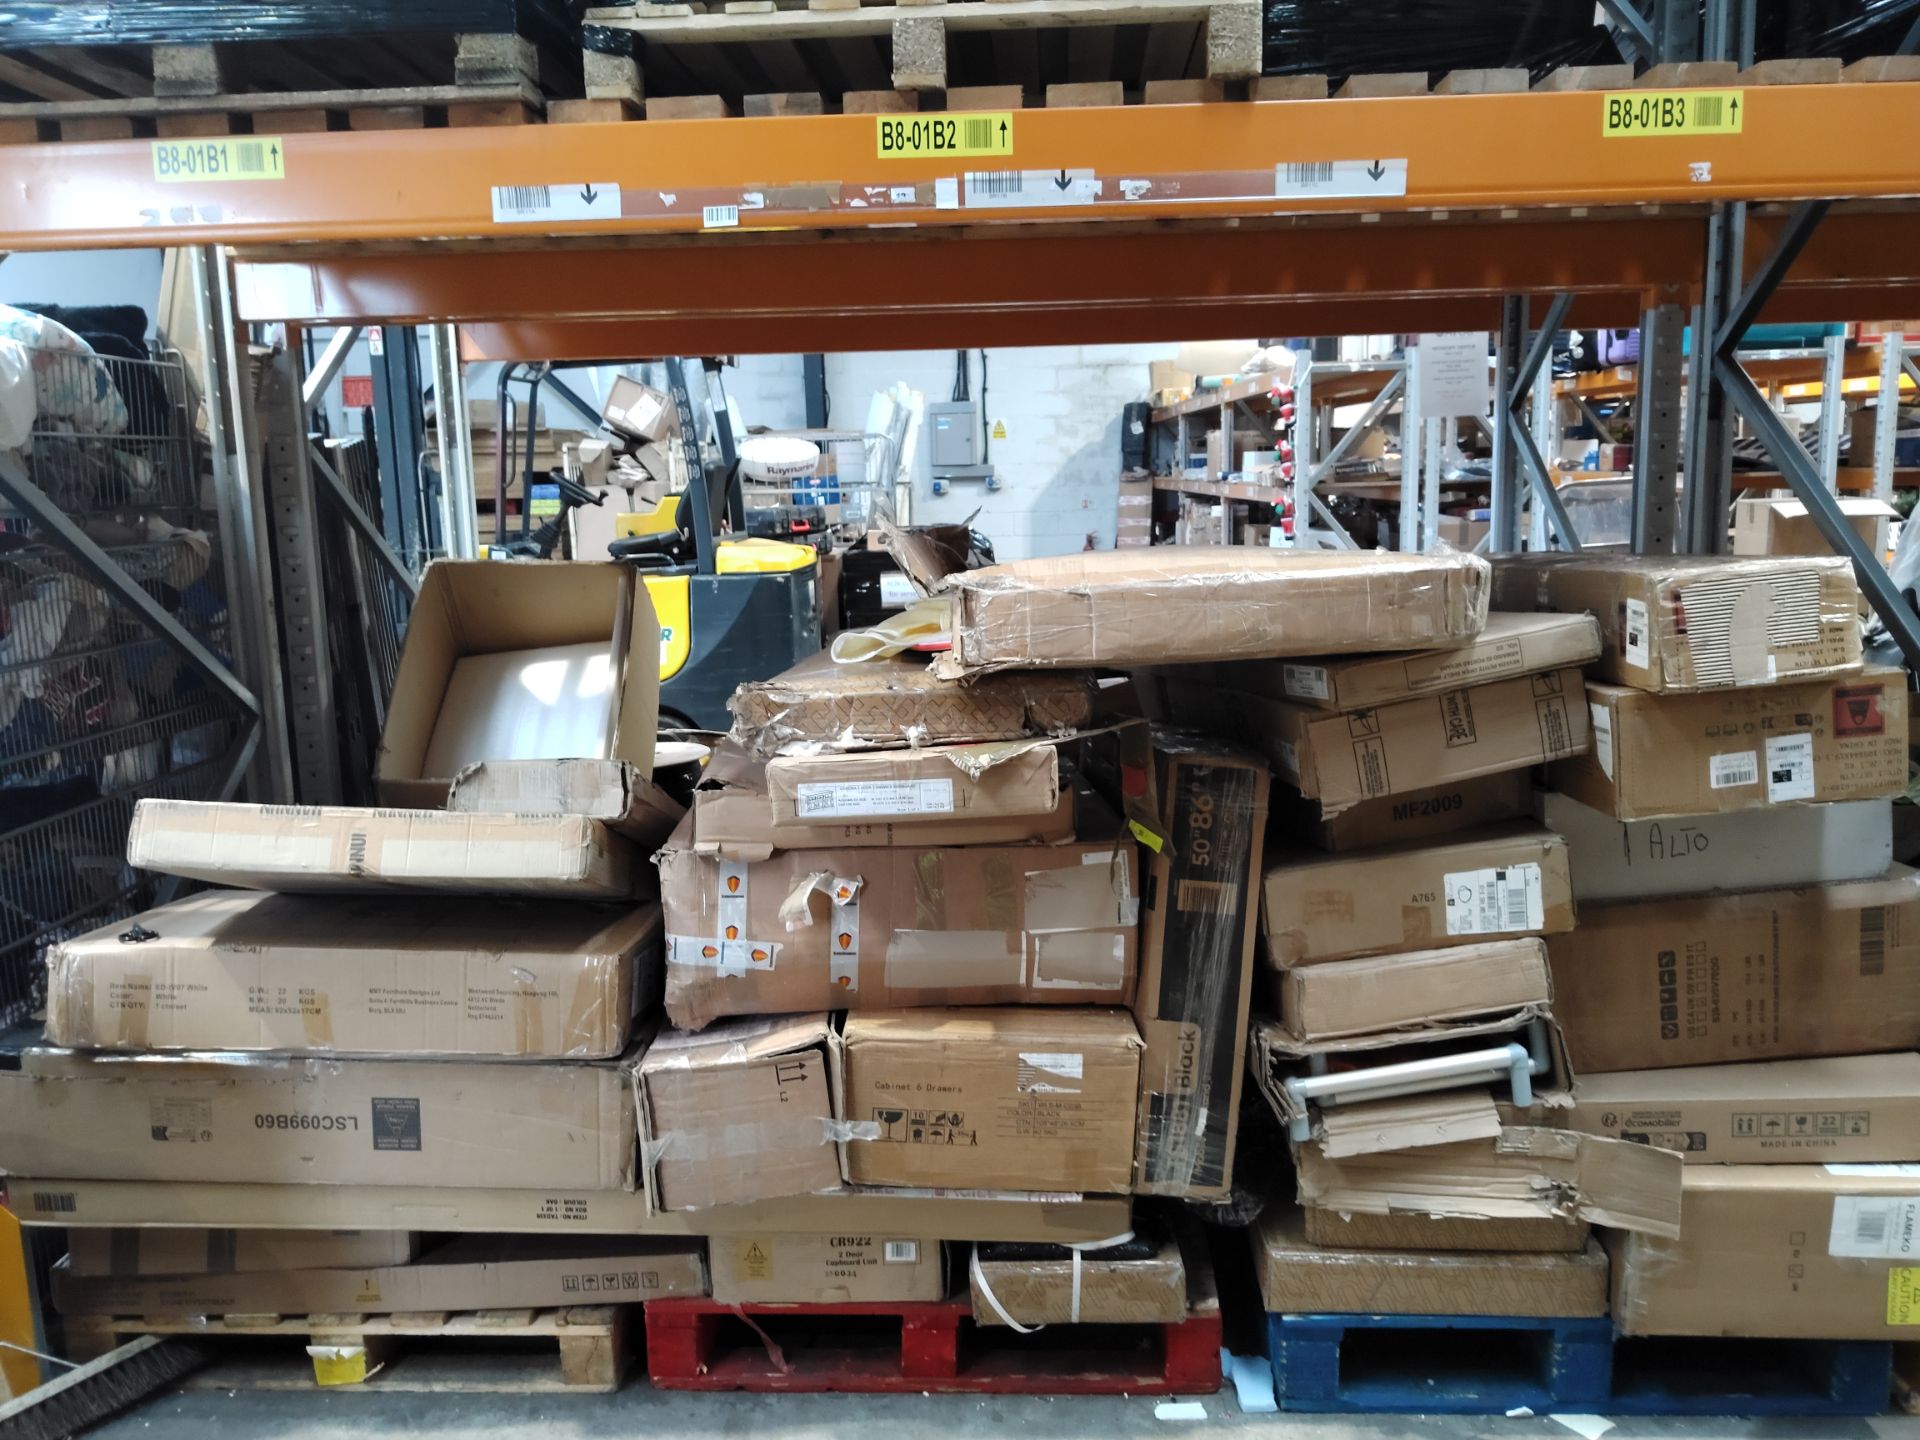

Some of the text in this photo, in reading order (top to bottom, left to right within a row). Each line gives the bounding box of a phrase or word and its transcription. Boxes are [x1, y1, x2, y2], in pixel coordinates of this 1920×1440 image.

[1609, 98, 1685, 129] B8-01B3
[882, 120, 956, 151] B8-01B2
[157, 143, 229, 175] B8-01B1
[1392, 793, 1463, 821] MF2009
[1649, 823, 1709, 859] ALTO
[1411, 892, 1437, 903] A765
[187, 984, 208, 992] White
[1173, 1028, 1197, 1089] Black
[874, 1081, 963, 1093] Cabinet 6 Drawers
[255, 1113, 359, 1131] LSC099B60
[1821, 1116, 1837, 1126] 22
[1760, 1138, 1838, 1148] MADE IN CHINA
[1900, 1203, 1916, 1253] FLAMEKO
[830, 1236, 872, 1248] CR922
[825, 1257, 878, 1266] Cupboard Unit
[1899, 1265, 1913, 1324] CAUTION
